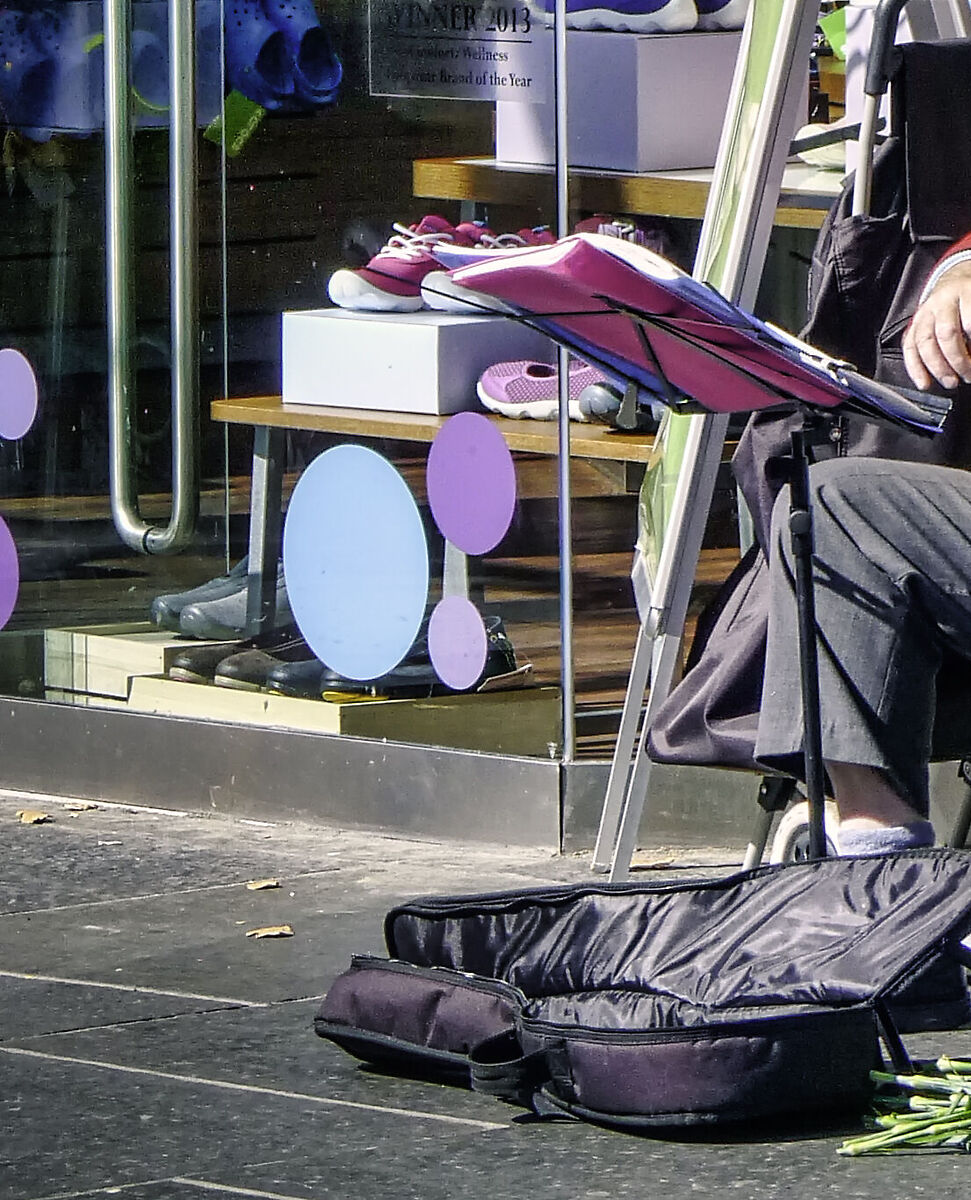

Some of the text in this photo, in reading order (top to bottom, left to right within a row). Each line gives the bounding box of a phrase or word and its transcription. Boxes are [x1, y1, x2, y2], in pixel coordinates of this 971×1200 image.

[485, 7, 531, 34] 2013
[476, 72, 488, 87] of
[490, 73, 508, 87] the
[509, 74, 532, 87] Year
